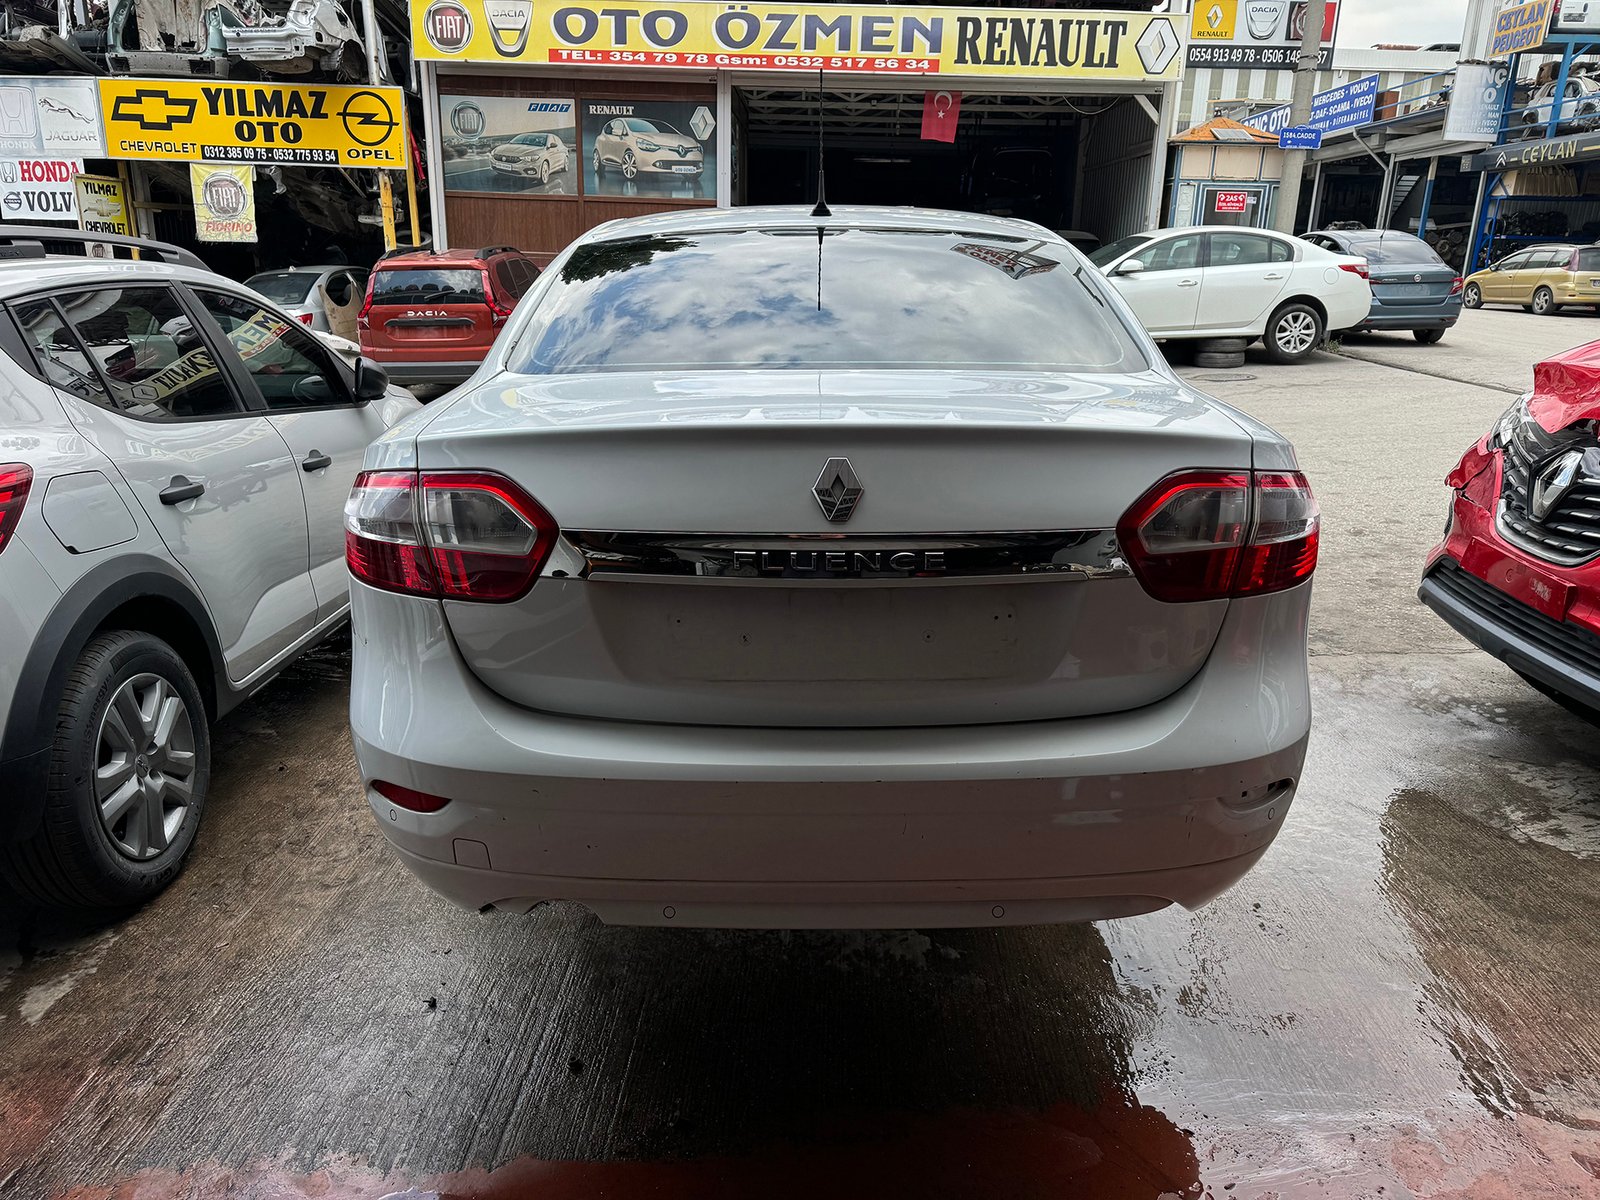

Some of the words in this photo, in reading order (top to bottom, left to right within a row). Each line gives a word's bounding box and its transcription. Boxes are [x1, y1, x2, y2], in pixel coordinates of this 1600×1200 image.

[492, 9, 525, 18] DACIA
[1497, 2, 1547, 33] CEYLAN
[435, 15, 462, 39] FIAT
[551, 7, 688, 48] OTO
[712, 5, 943, 54] ÖZMEN
[954, 16, 1127, 69] RENAULT
[1492, 25, 1542, 54] PEUGEOT
[558, 49, 602, 60] TEL:
[609, 52, 646, 62] 354
[652, 53, 677, 63] 79
[684, 54, 709, 64] 78
[714, 55, 767, 66] Gsm:
[773, 57, 824, 67] 0532
[830, 57, 868, 68] 517
[873, 58, 899, 69] 56
[904, 59, 930, 69] 34
[1190, 47, 1212, 62] 0554
[1212, 48, 1229, 62] 913
[1231, 48, 1243, 62] 49
[1243, 49, 1255, 63] 78
[1262, 49, 1284, 63] 0506
[201, 87, 329, 119] YILMAZ
[1313, 88, 1345, 107] MERCEDES
[1349, 80, 1370, 96] VOLVO
[528, 103, 571, 113] FIAT
[589, 105, 635, 115] RENAULT
[460, 113, 478, 129] FIAT
[1269, 107, 1291, 132] OTO
[45, 130, 97, 141] JAGUAR
[235, 120, 303, 144] OTO
[0, 141, 37, 149] HONDA
[120, 140, 197, 153] CHEVROLET
[204, 146, 225, 158] 0312
[226, 147, 241, 159] 385
[243, 147, 255, 159] 09
[256, 148, 267, 160] 75
[273, 149, 294, 160] 0532
[295, 149, 310, 161] 775
[312, 150, 323, 161] 93
[325, 150, 336, 161] 54
[346, 149, 395, 160] OPEL
[1521, 140, 1578, 164] CEYLAN
[18, 160, 79, 182] HONDA
[83, 181, 117, 196] YILMAZ
[212, 187, 237, 208] FIAT
[23, 190, 76, 212] VOLV
[85, 220, 126, 235] CHEVROLET
[206, 221, 253, 232] FIORINO
[734, 551, 946, 571] FLUENCE
